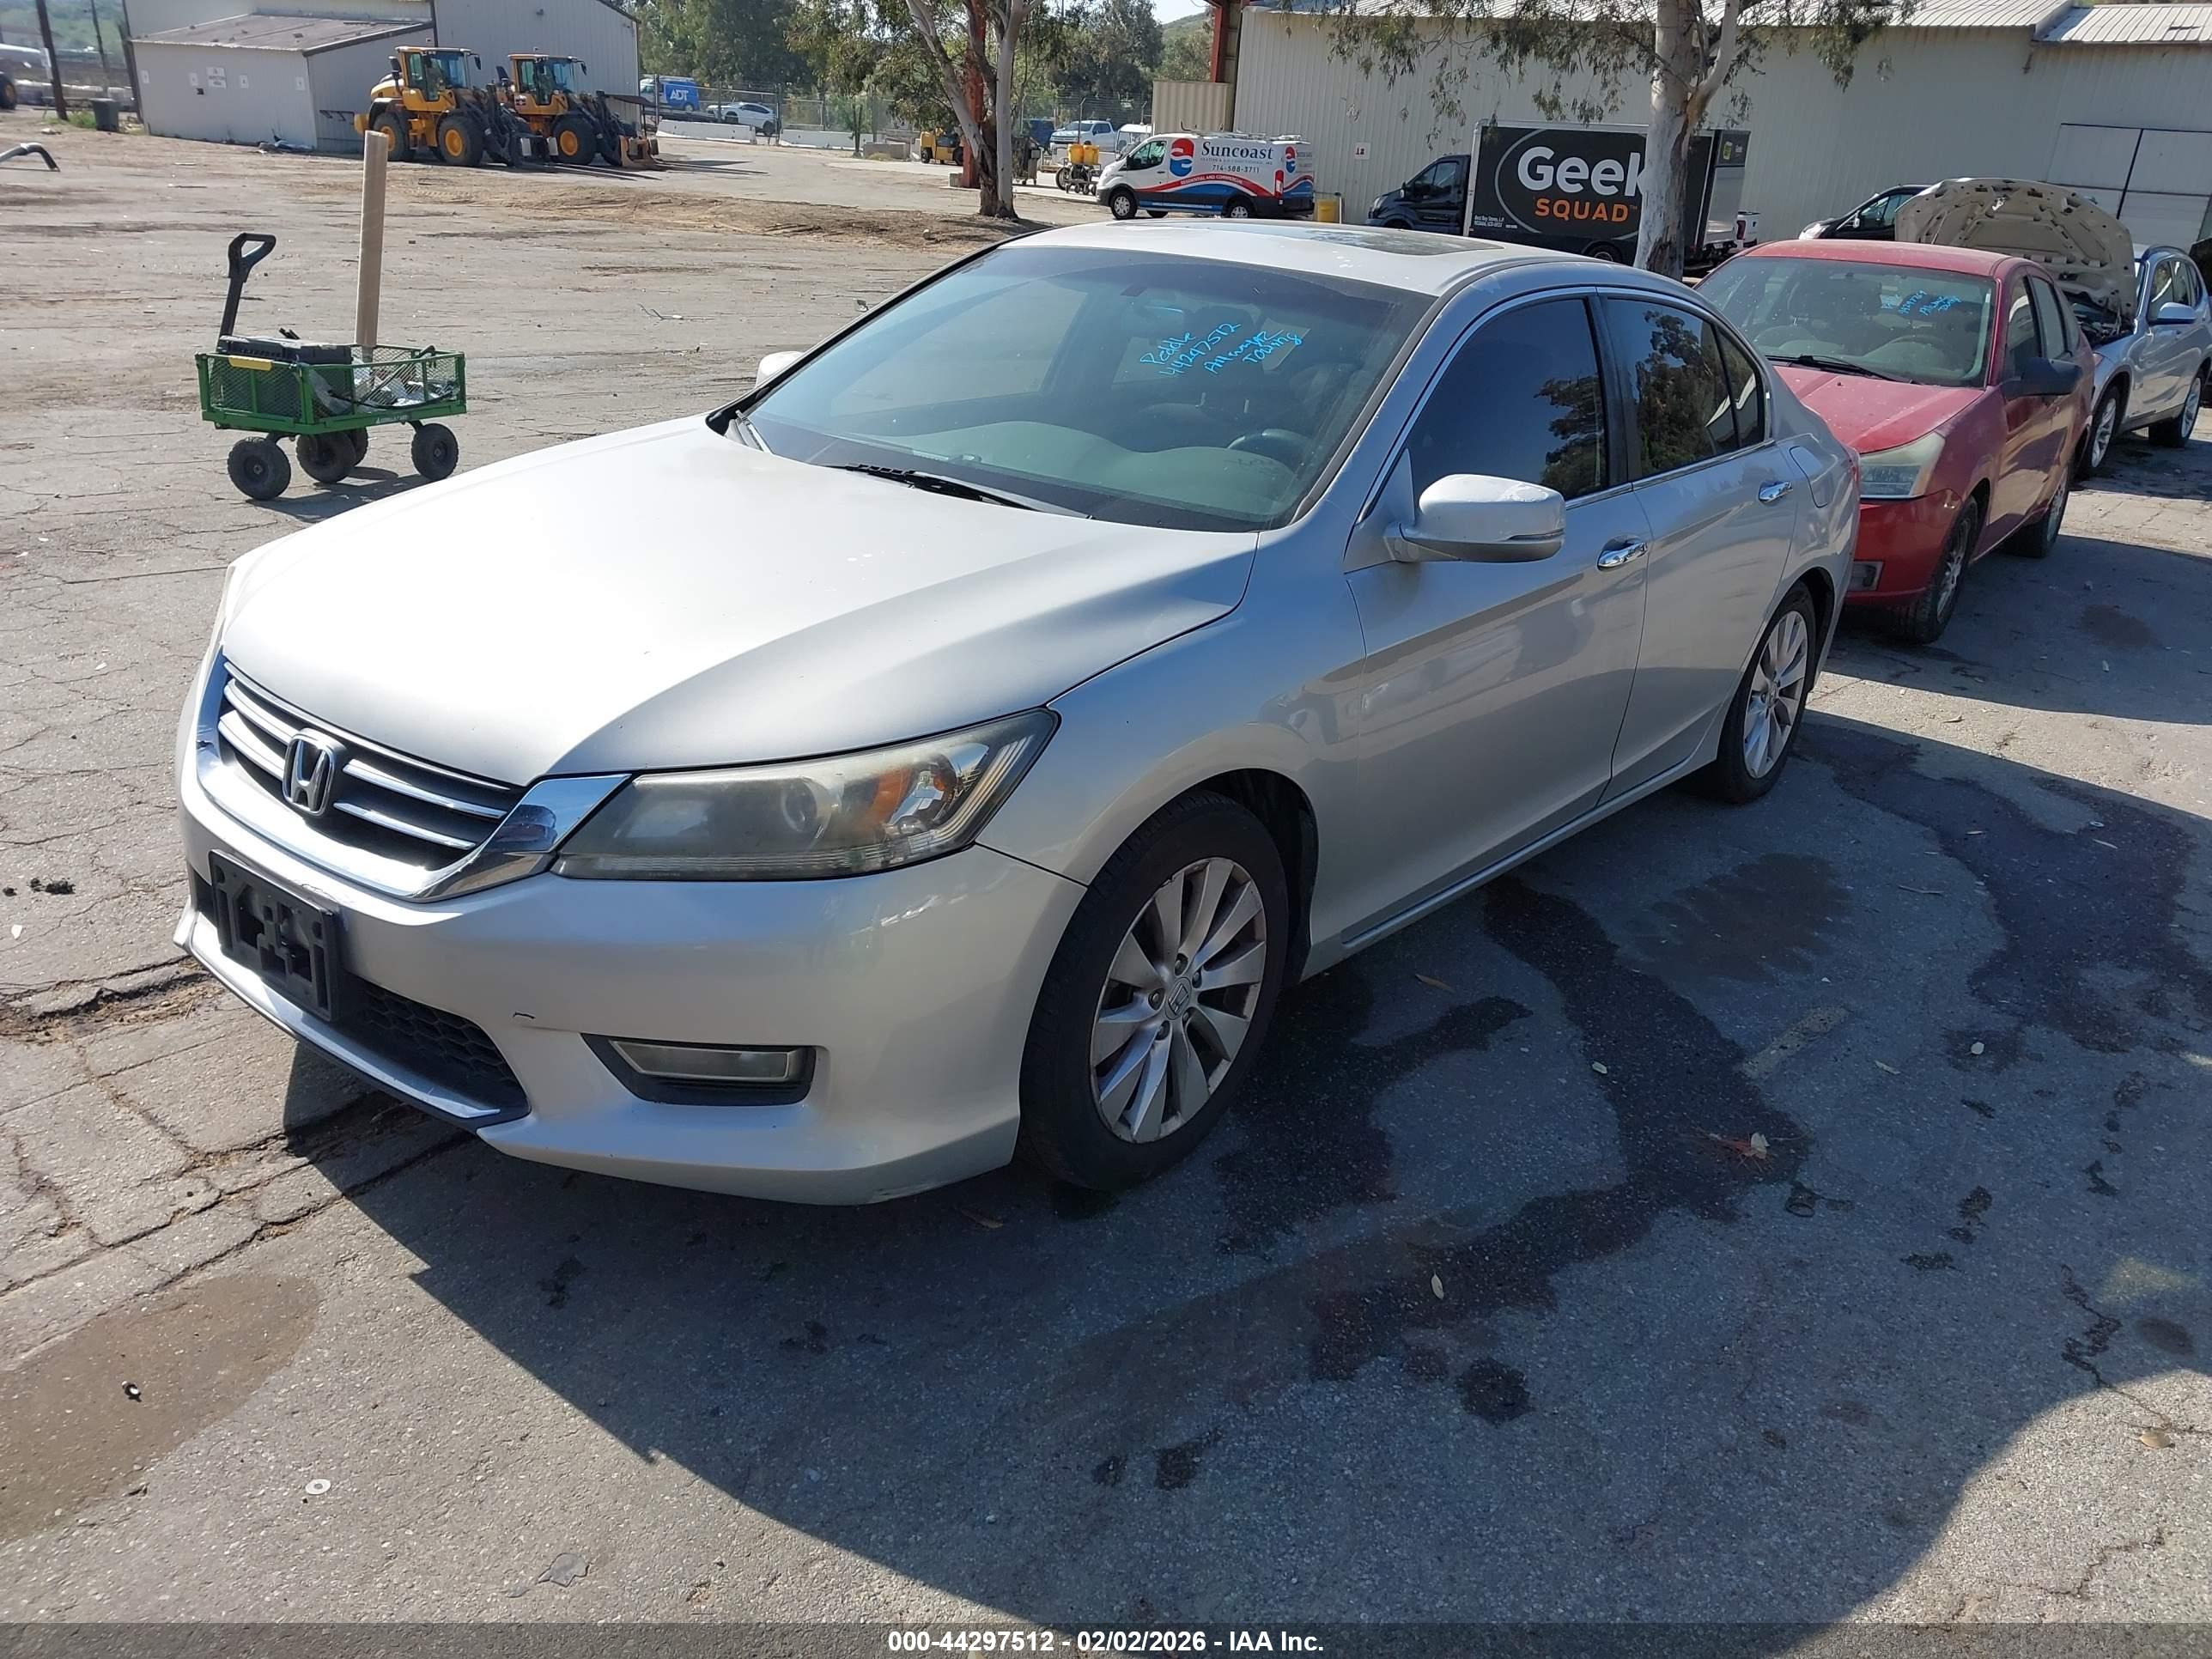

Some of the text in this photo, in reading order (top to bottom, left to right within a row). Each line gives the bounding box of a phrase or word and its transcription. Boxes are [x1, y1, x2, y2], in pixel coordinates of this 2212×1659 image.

[670, 88, 689, 100] ADT
[1201, 141, 1273, 160] Suncoast
[1534, 198, 1629, 222] SQUAD
[1158, 323, 1242, 375] 44297512
